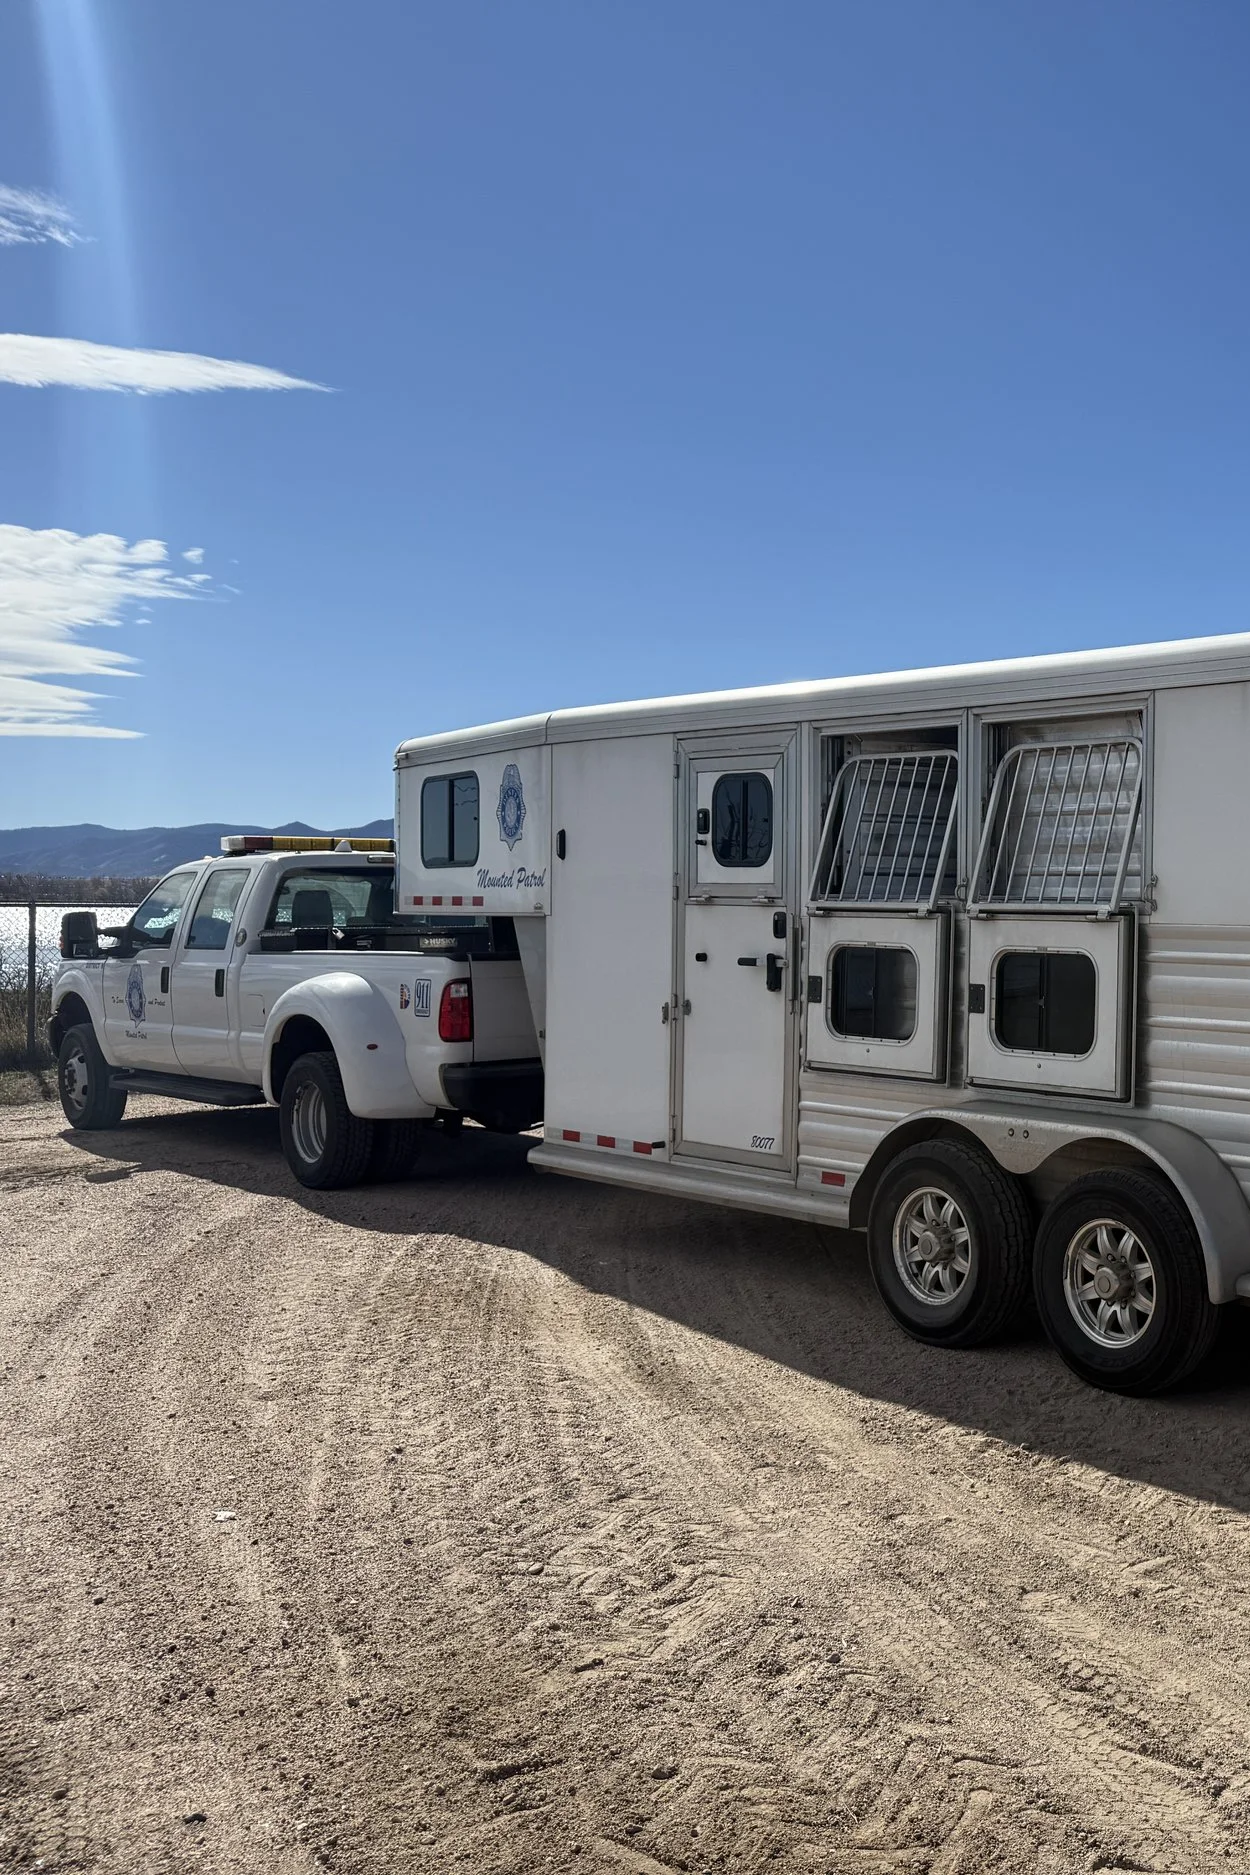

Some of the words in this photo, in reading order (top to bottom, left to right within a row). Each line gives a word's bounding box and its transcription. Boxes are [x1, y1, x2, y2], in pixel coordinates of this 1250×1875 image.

[476, 868, 514, 889] Mounted
[516, 867, 546, 889] Patrol
[430, 937, 456, 945] HUSKY
[416, 981, 429, 1009] 911
